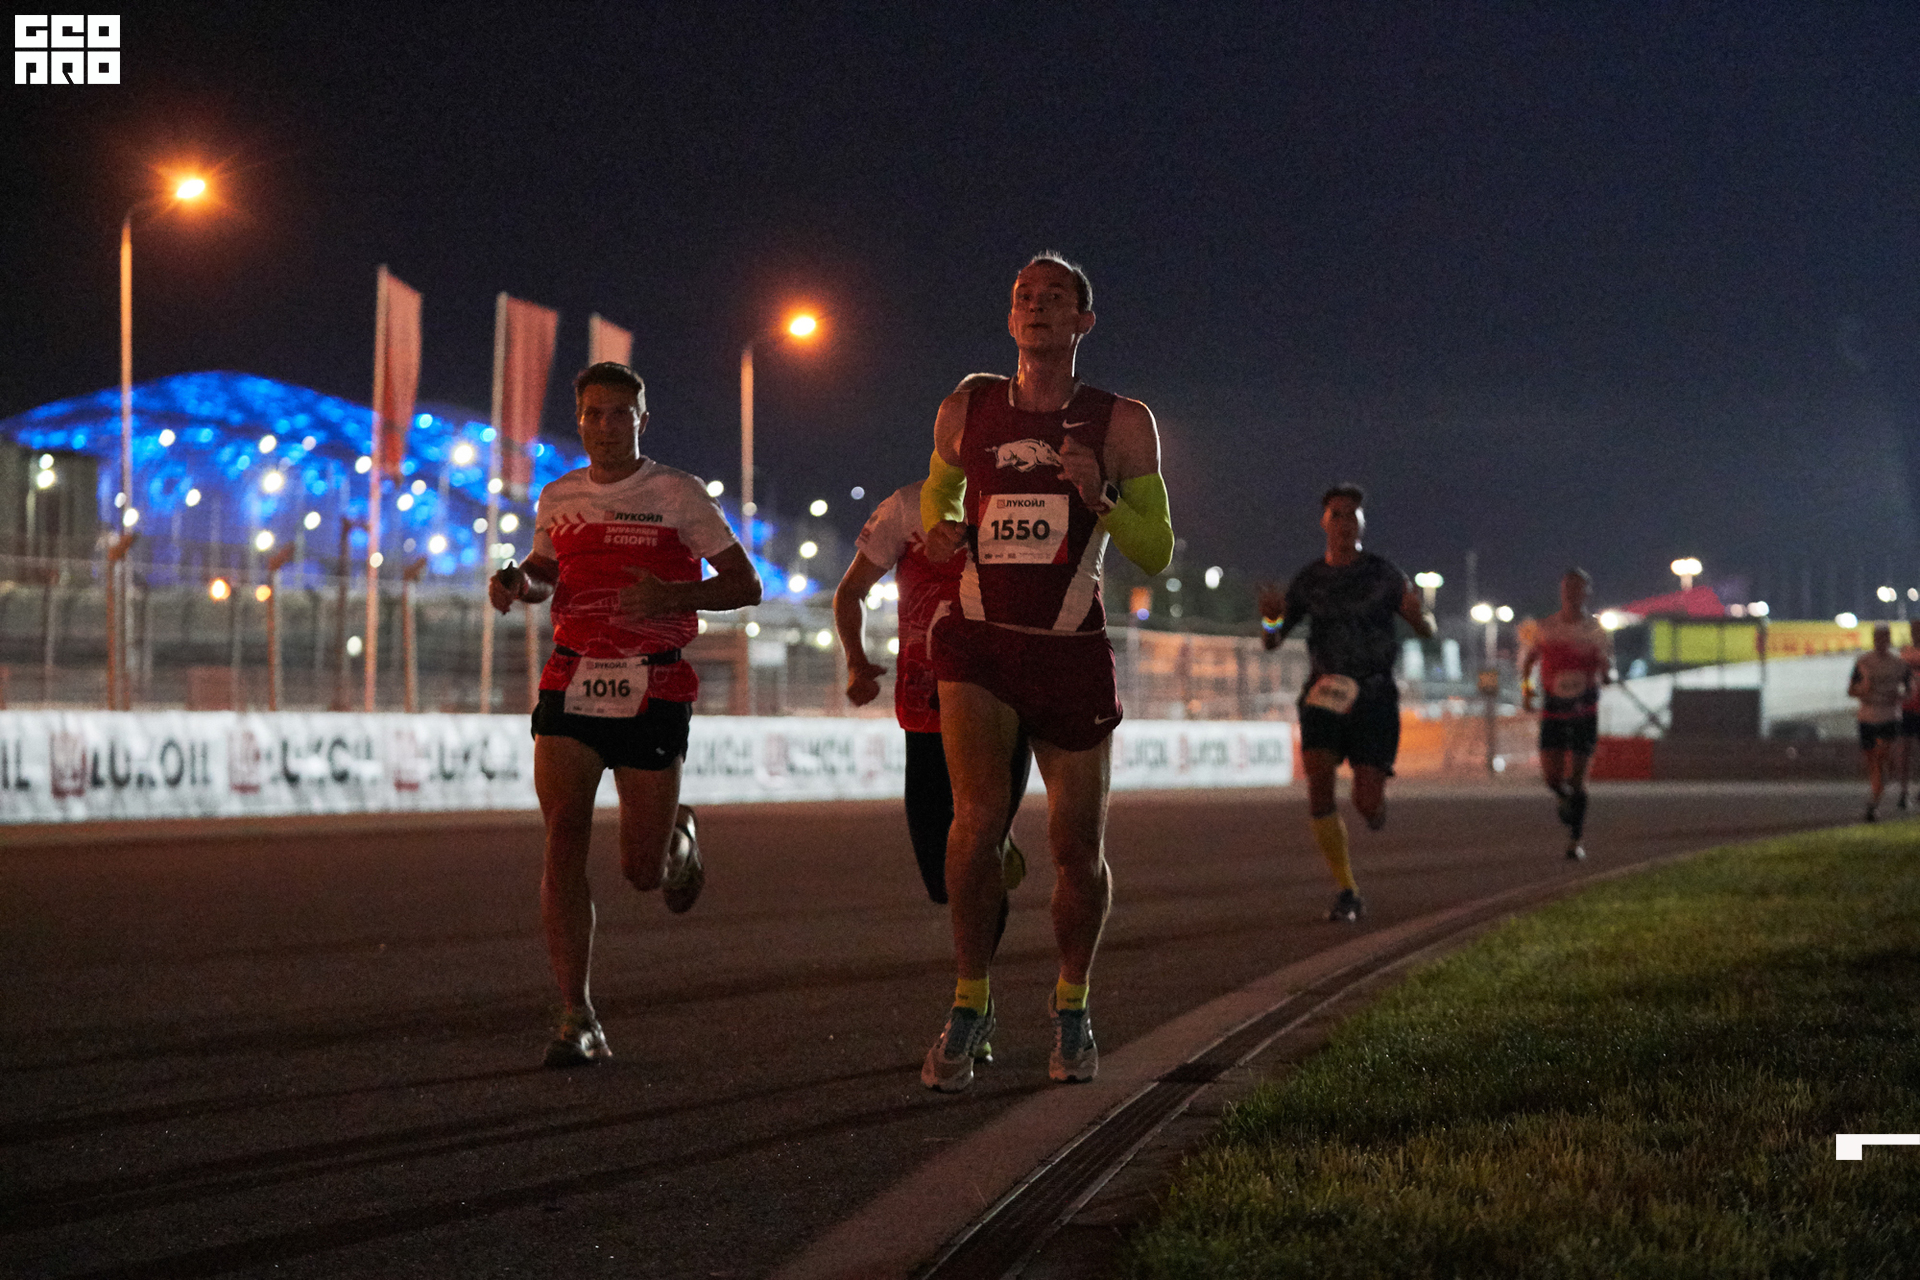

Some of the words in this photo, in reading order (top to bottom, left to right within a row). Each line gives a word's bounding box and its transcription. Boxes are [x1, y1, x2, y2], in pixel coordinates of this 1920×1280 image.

[1005, 498, 1045, 508] ЛУКОЙЛ
[614, 512, 663, 522] ЛУКОЙЛ
[991, 519, 1050, 541] 1550
[613, 535, 658, 546] СПОРТЕ
[582, 678, 631, 698] 1016
